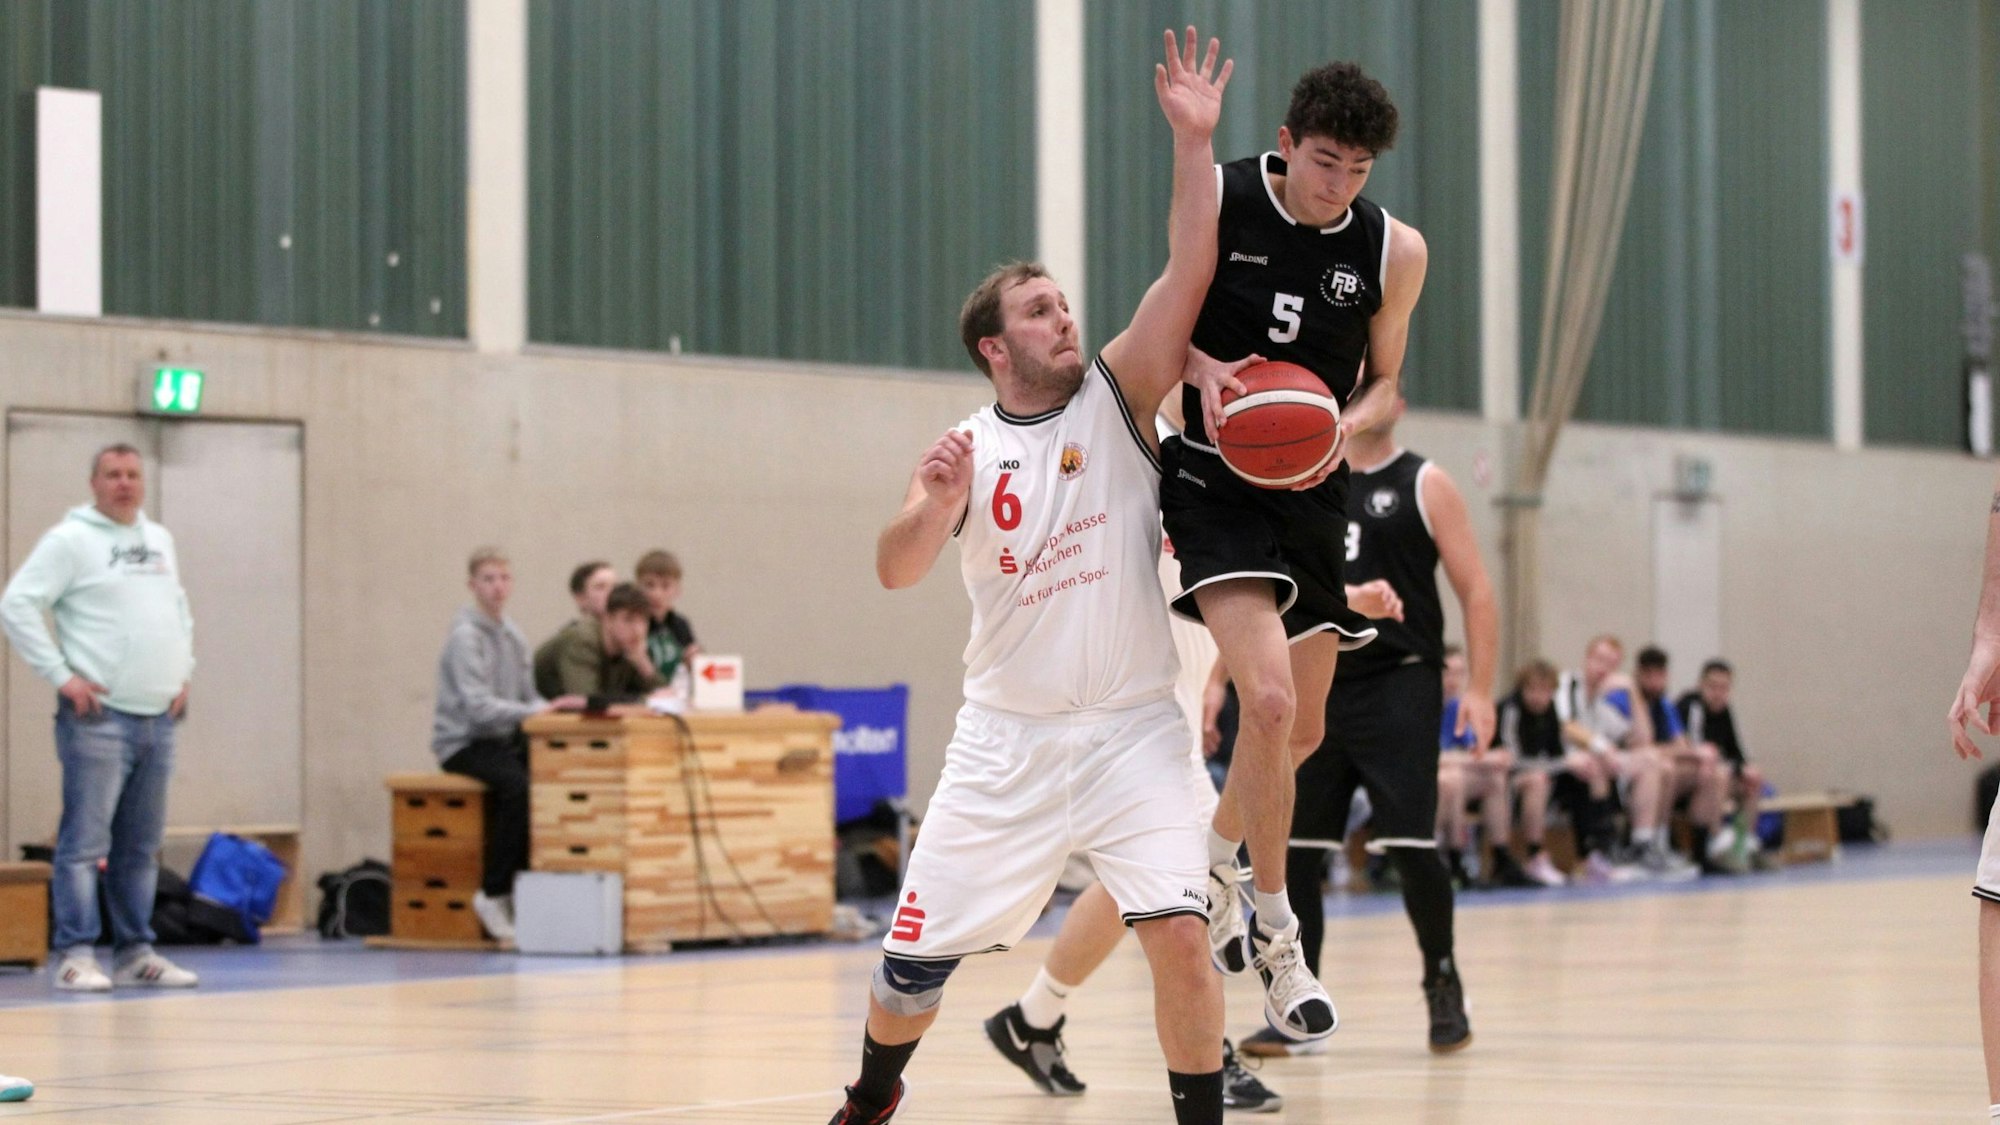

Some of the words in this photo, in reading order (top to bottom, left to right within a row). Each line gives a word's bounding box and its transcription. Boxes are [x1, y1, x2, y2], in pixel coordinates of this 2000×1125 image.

[1229, 252, 1268, 266] SPALDING
[1268, 292, 1304, 343] 5
[991, 472, 1023, 531] 6
[1017, 594, 1035, 607] ut
